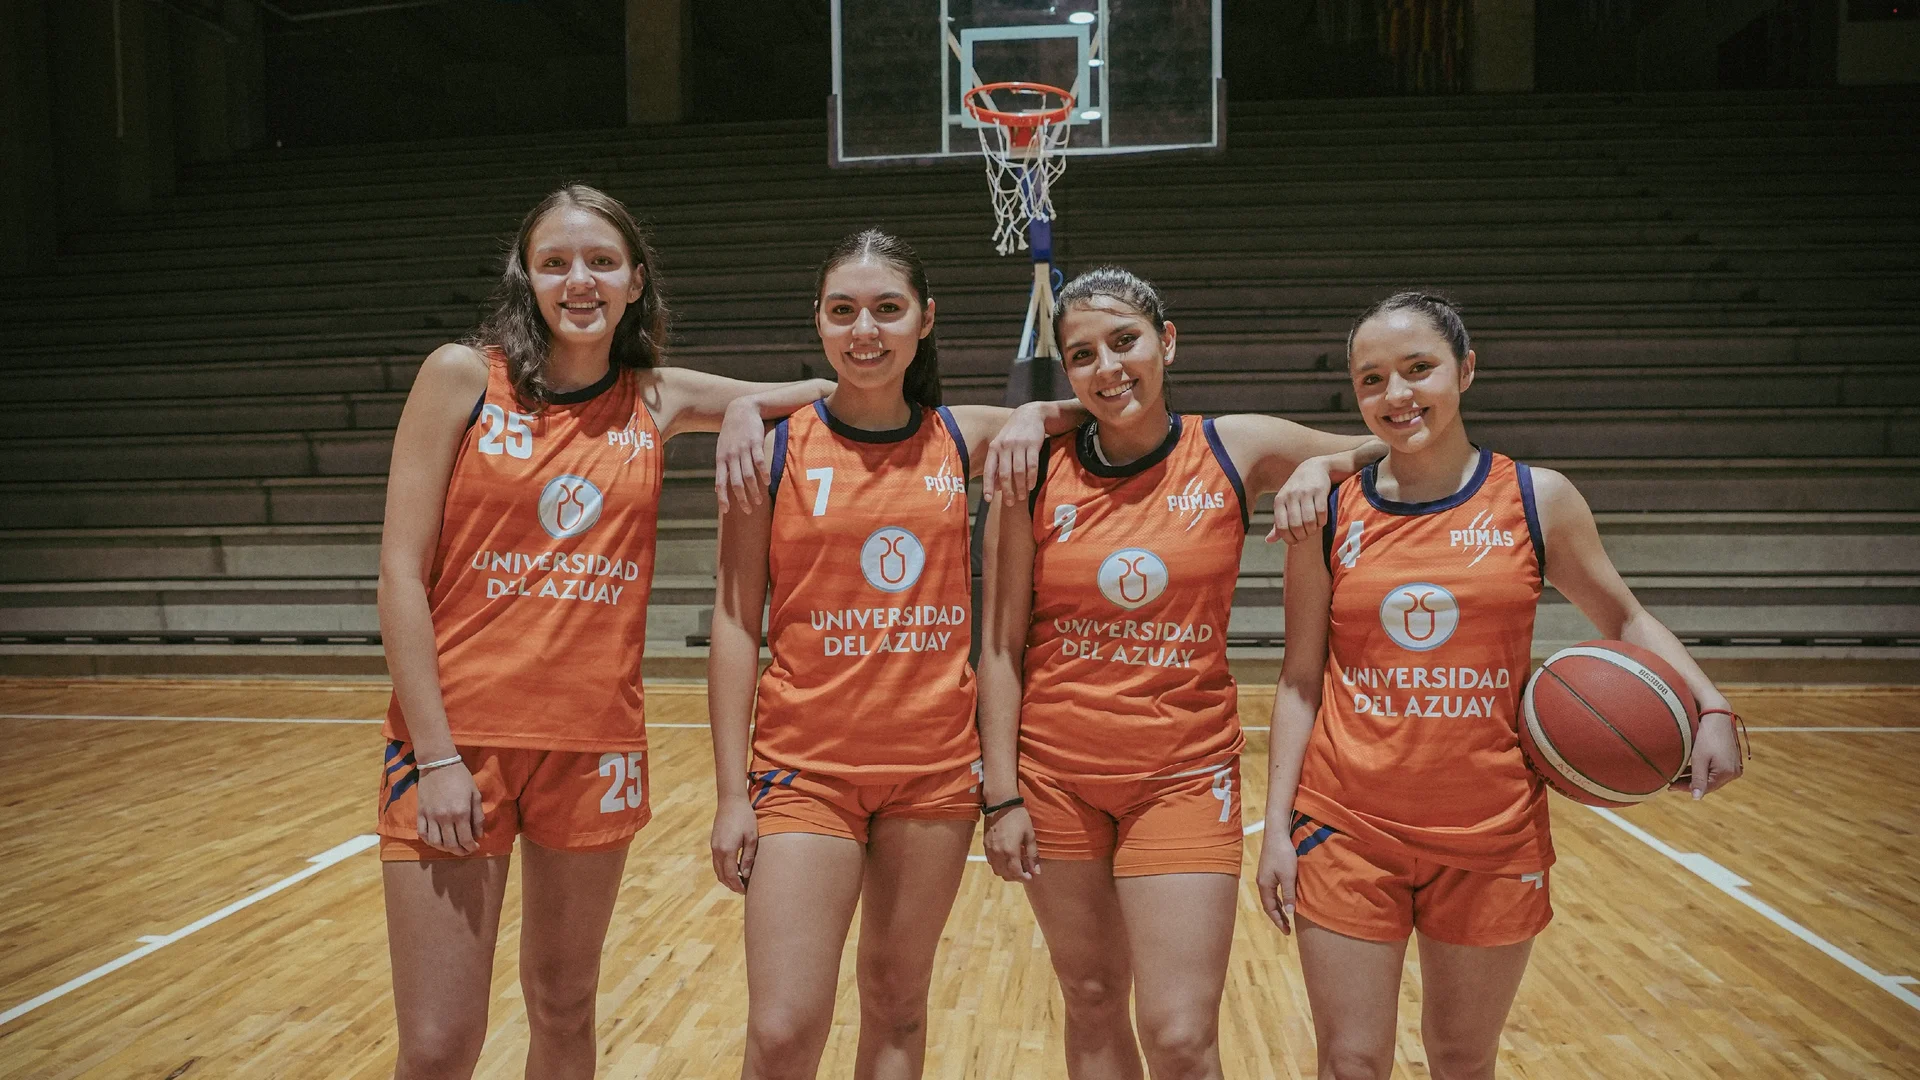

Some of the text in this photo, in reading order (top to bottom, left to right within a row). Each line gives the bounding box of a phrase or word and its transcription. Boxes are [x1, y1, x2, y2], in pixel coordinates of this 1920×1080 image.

[478, 403, 534, 459] 25
[806, 467, 834, 516] 7
[1167, 491, 1225, 512] PUMAS
[1053, 503, 1078, 543] 9
[1337, 520, 1365, 568] 4
[1450, 529, 1514, 547] PUMAS
[471, 550, 639, 581] UNIVERSIDAD
[486, 577, 624, 605] DEL AZUAY
[810, 605, 965, 631] UNIVERSIDAD
[1053, 618, 1213, 643] UNIVERSIDAD
[824, 631, 952, 657] DEL AZUAY
[1061, 638, 1196, 668] DEL AZUAY
[1342, 666, 1510, 689] UNIVERSIDAD
[1354, 694, 1496, 718] DEL AZUAY
[599, 751, 642, 814] 25
[1211, 766, 1233, 823] 9
